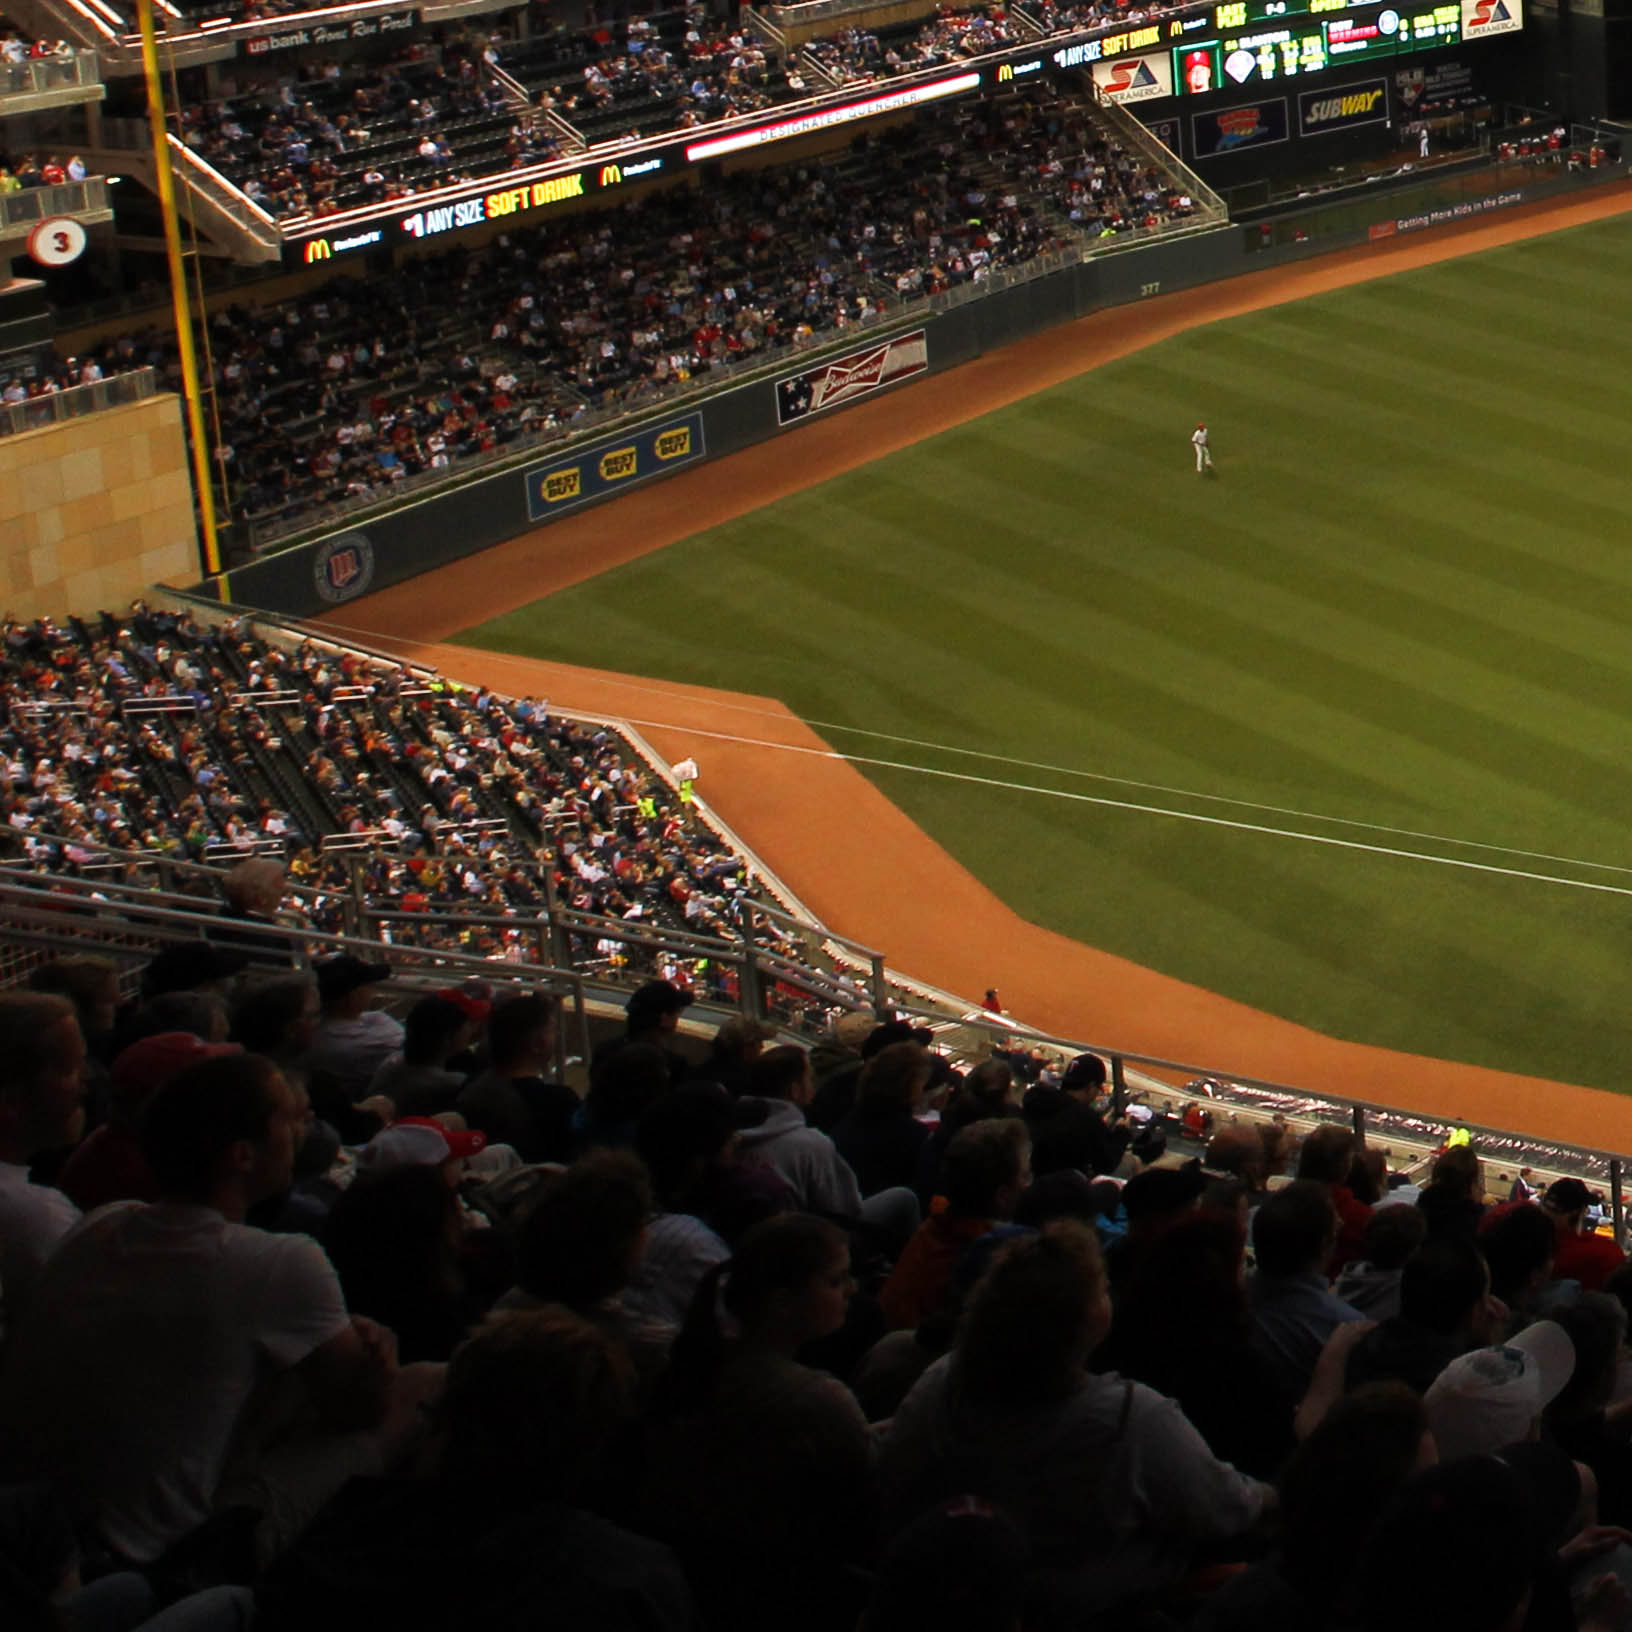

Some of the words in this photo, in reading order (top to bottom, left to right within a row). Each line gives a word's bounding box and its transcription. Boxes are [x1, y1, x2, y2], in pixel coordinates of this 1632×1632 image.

[1216, 2, 1247, 17] LAST
[1216, 15, 1247, 29] PLAY
[249, 30, 311, 55] usbank
[1067, 45, 1085, 66] ANY
[1085, 41, 1102, 63] SIZE
[1102, 34, 1129, 57] SOFT
[1129, 26, 1160, 50] DRINK
[1306, 89, 1383, 124] SUBWAY
[760, 108, 843, 142] DESIGNATED
[426, 206, 455, 235] ANY
[455, 198, 485, 228] SIZE
[486, 186, 531, 218] SOFT
[531, 173, 584, 208] DRINK
[1396, 214, 1430, 230] Getting
[1430, 209, 1452, 223] More
[1453, 203, 1472, 217] Kids
[1484, 197, 1497, 208] the
[1497, 192, 1523, 207] Game
[53, 231, 72, 253] 3
[823, 361, 884, 393] Budweiser
[658, 431, 691, 449] BEST
[660, 442, 688, 458] BUY
[603, 451, 636, 470] BEST
[546, 472, 579, 490] BEST
[604, 463, 634, 479] BUY
[547, 483, 578, 502] BUY
